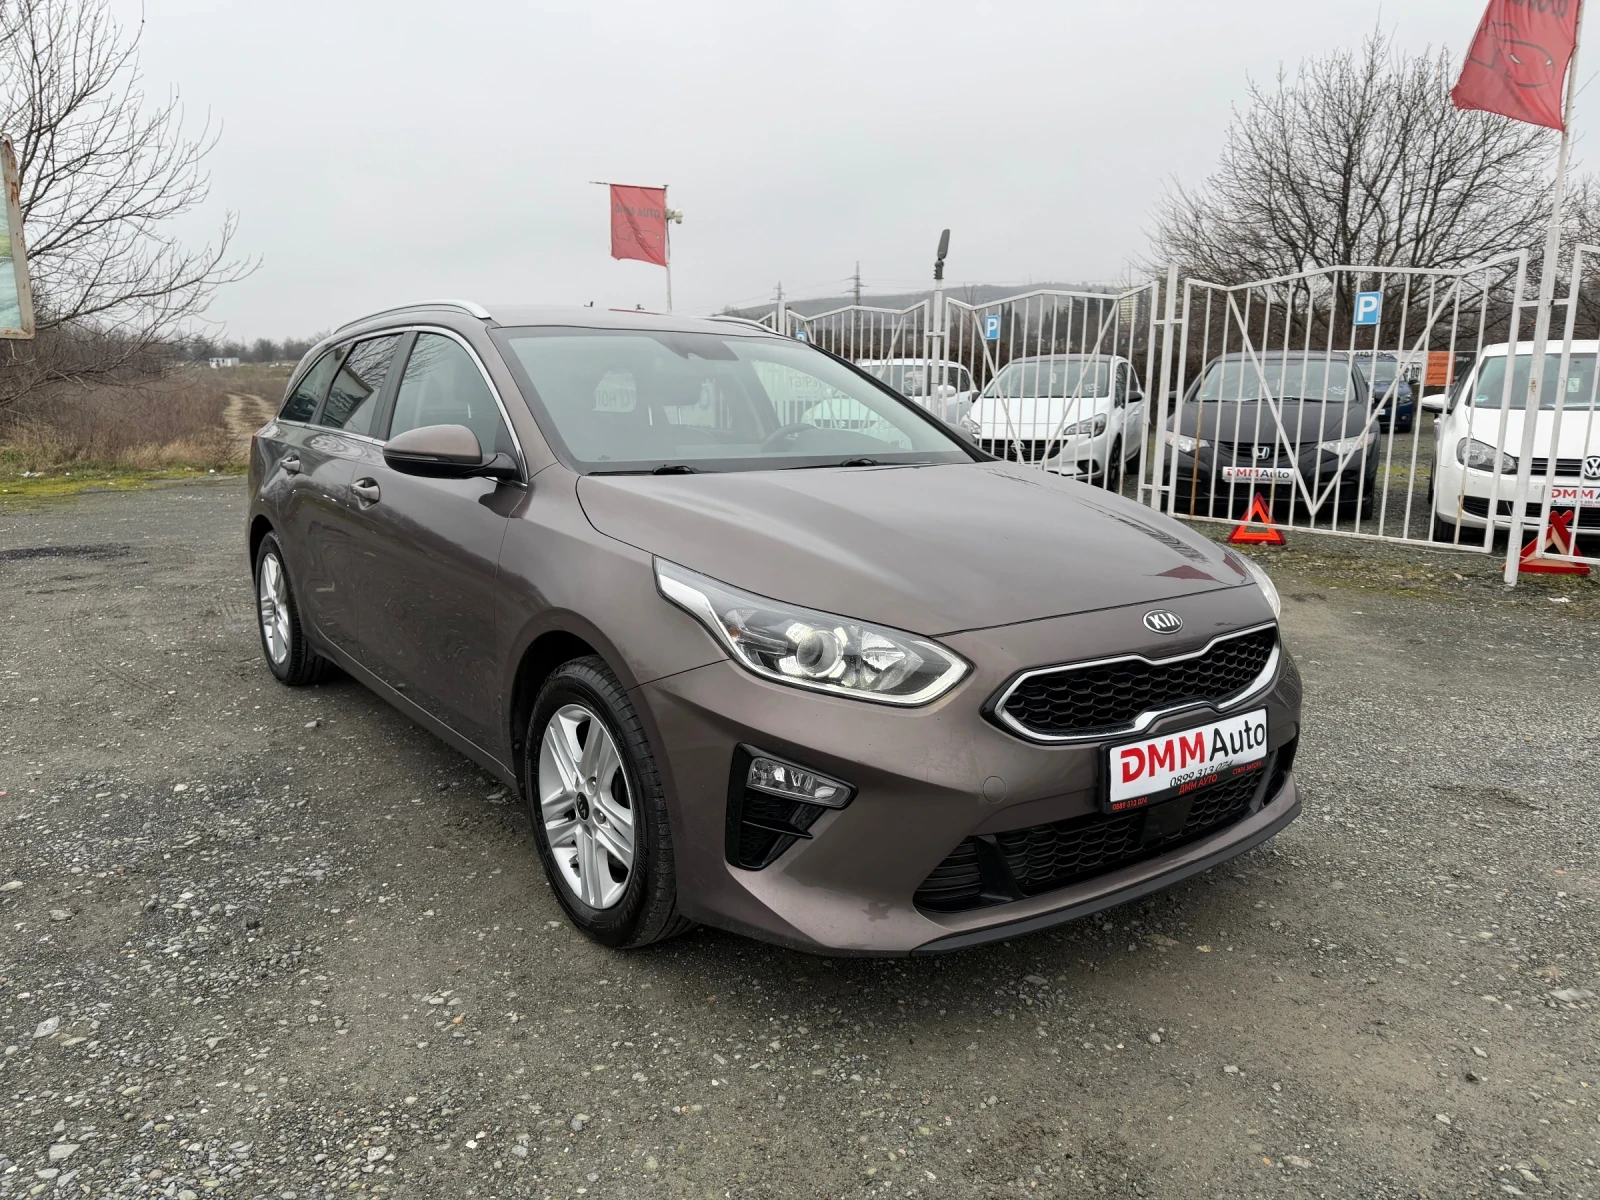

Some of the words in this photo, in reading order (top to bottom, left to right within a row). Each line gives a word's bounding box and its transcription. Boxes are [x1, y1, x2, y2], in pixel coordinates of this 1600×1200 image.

[637, 207, 661, 219] AUTO
[1357, 296, 1378, 322] P
[987, 318, 998, 337] P
[1551, 488, 1594, 500] DMM
[1147, 612, 1181, 629] KIA
[1120, 731, 1206, 784] DMM
[1209, 719, 1266, 762] Auto
[1196, 765, 1215, 778] 313
